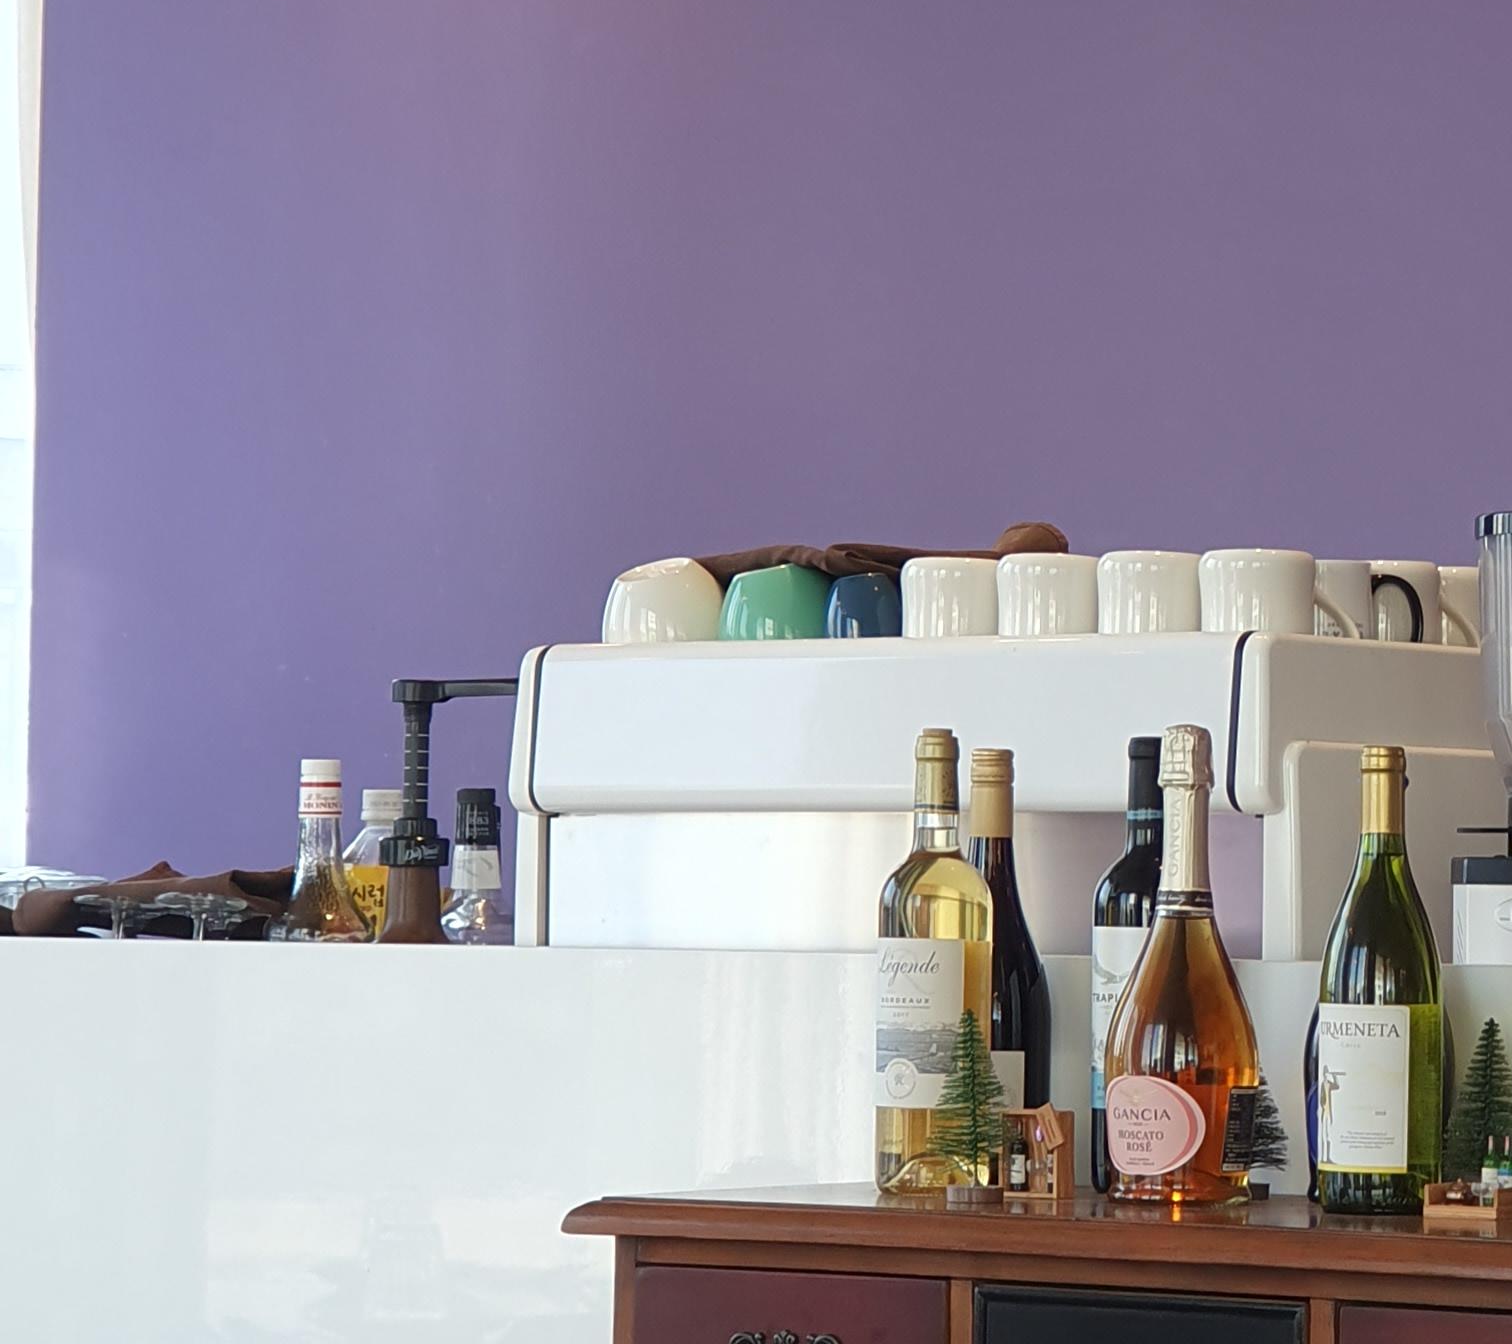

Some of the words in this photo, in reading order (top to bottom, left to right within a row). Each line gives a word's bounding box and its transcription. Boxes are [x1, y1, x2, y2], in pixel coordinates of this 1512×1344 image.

[1168, 798, 1182, 878] GANCIA
[1113, 1107, 1171, 1121] GANCIA
[1118, 1129, 1164, 1141] MOSCATO
